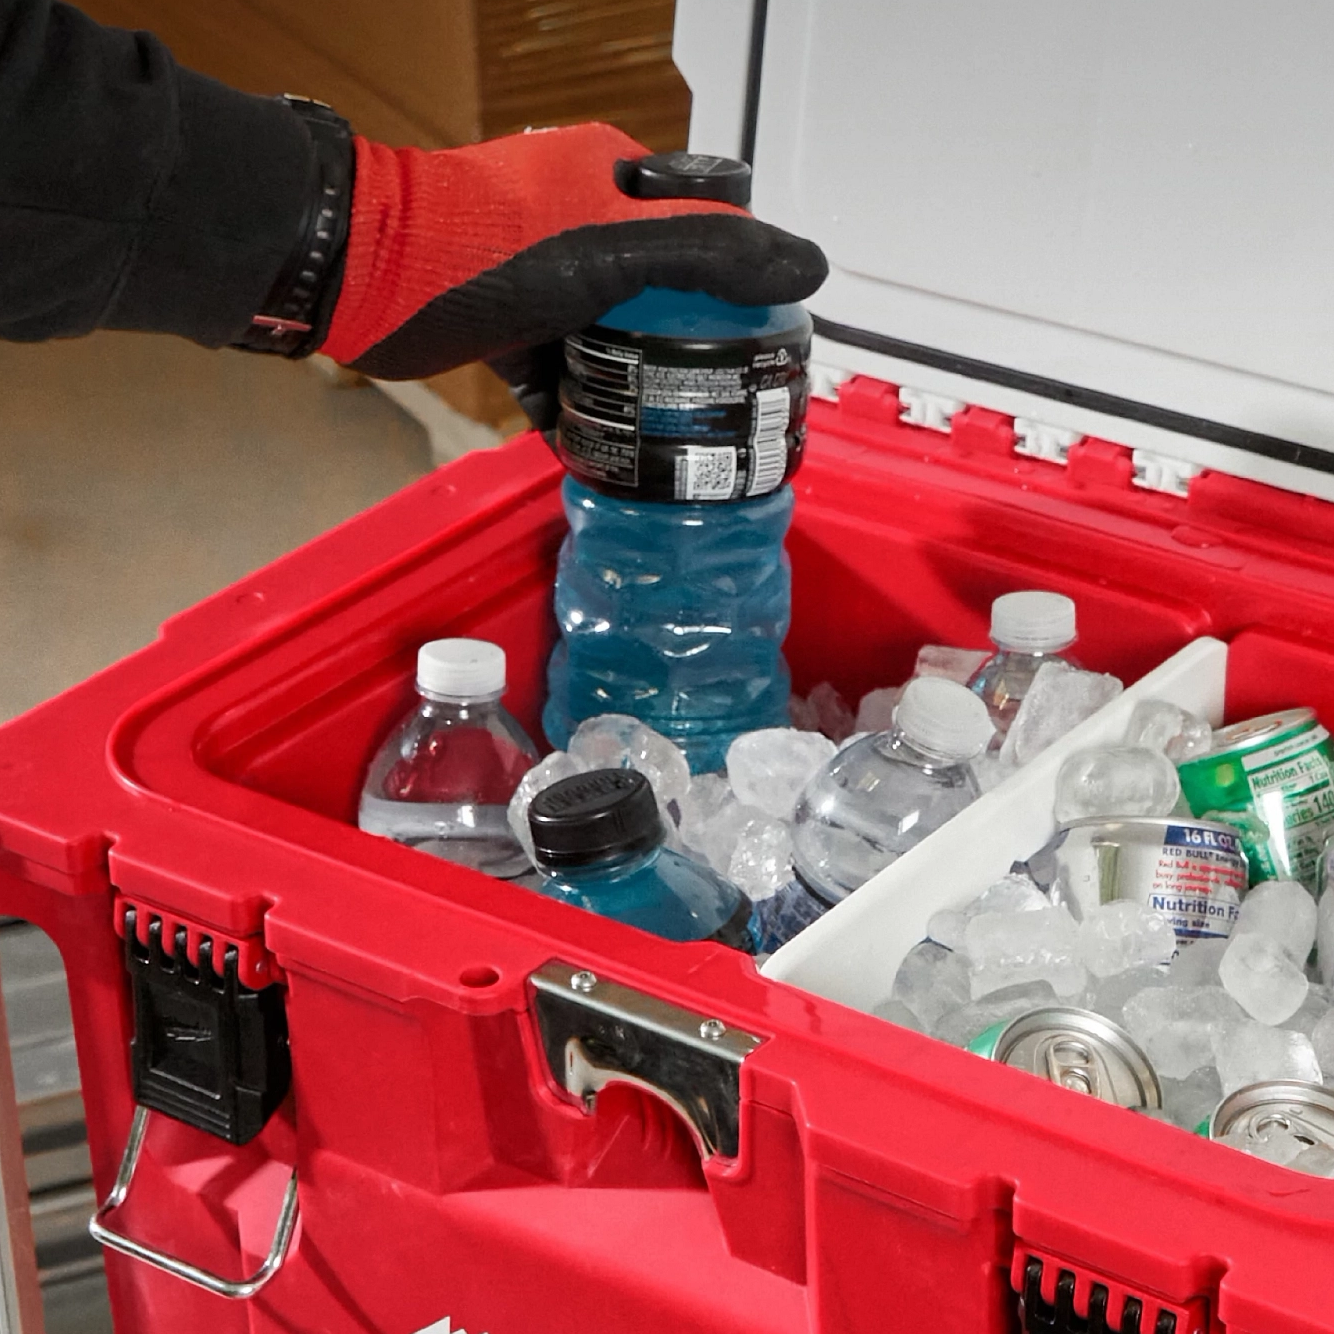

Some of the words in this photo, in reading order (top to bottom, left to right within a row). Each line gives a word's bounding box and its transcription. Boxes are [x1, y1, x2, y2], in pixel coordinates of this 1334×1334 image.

[1251, 767, 1298, 790] Nutrition
[1297, 756, 1324, 774] Facts
[1183, 828, 1202, 844] 16
[1203, 831, 1218, 847] FL
[1162, 847, 1182, 857] RED
[1151, 895, 1225, 918] Nutrition
